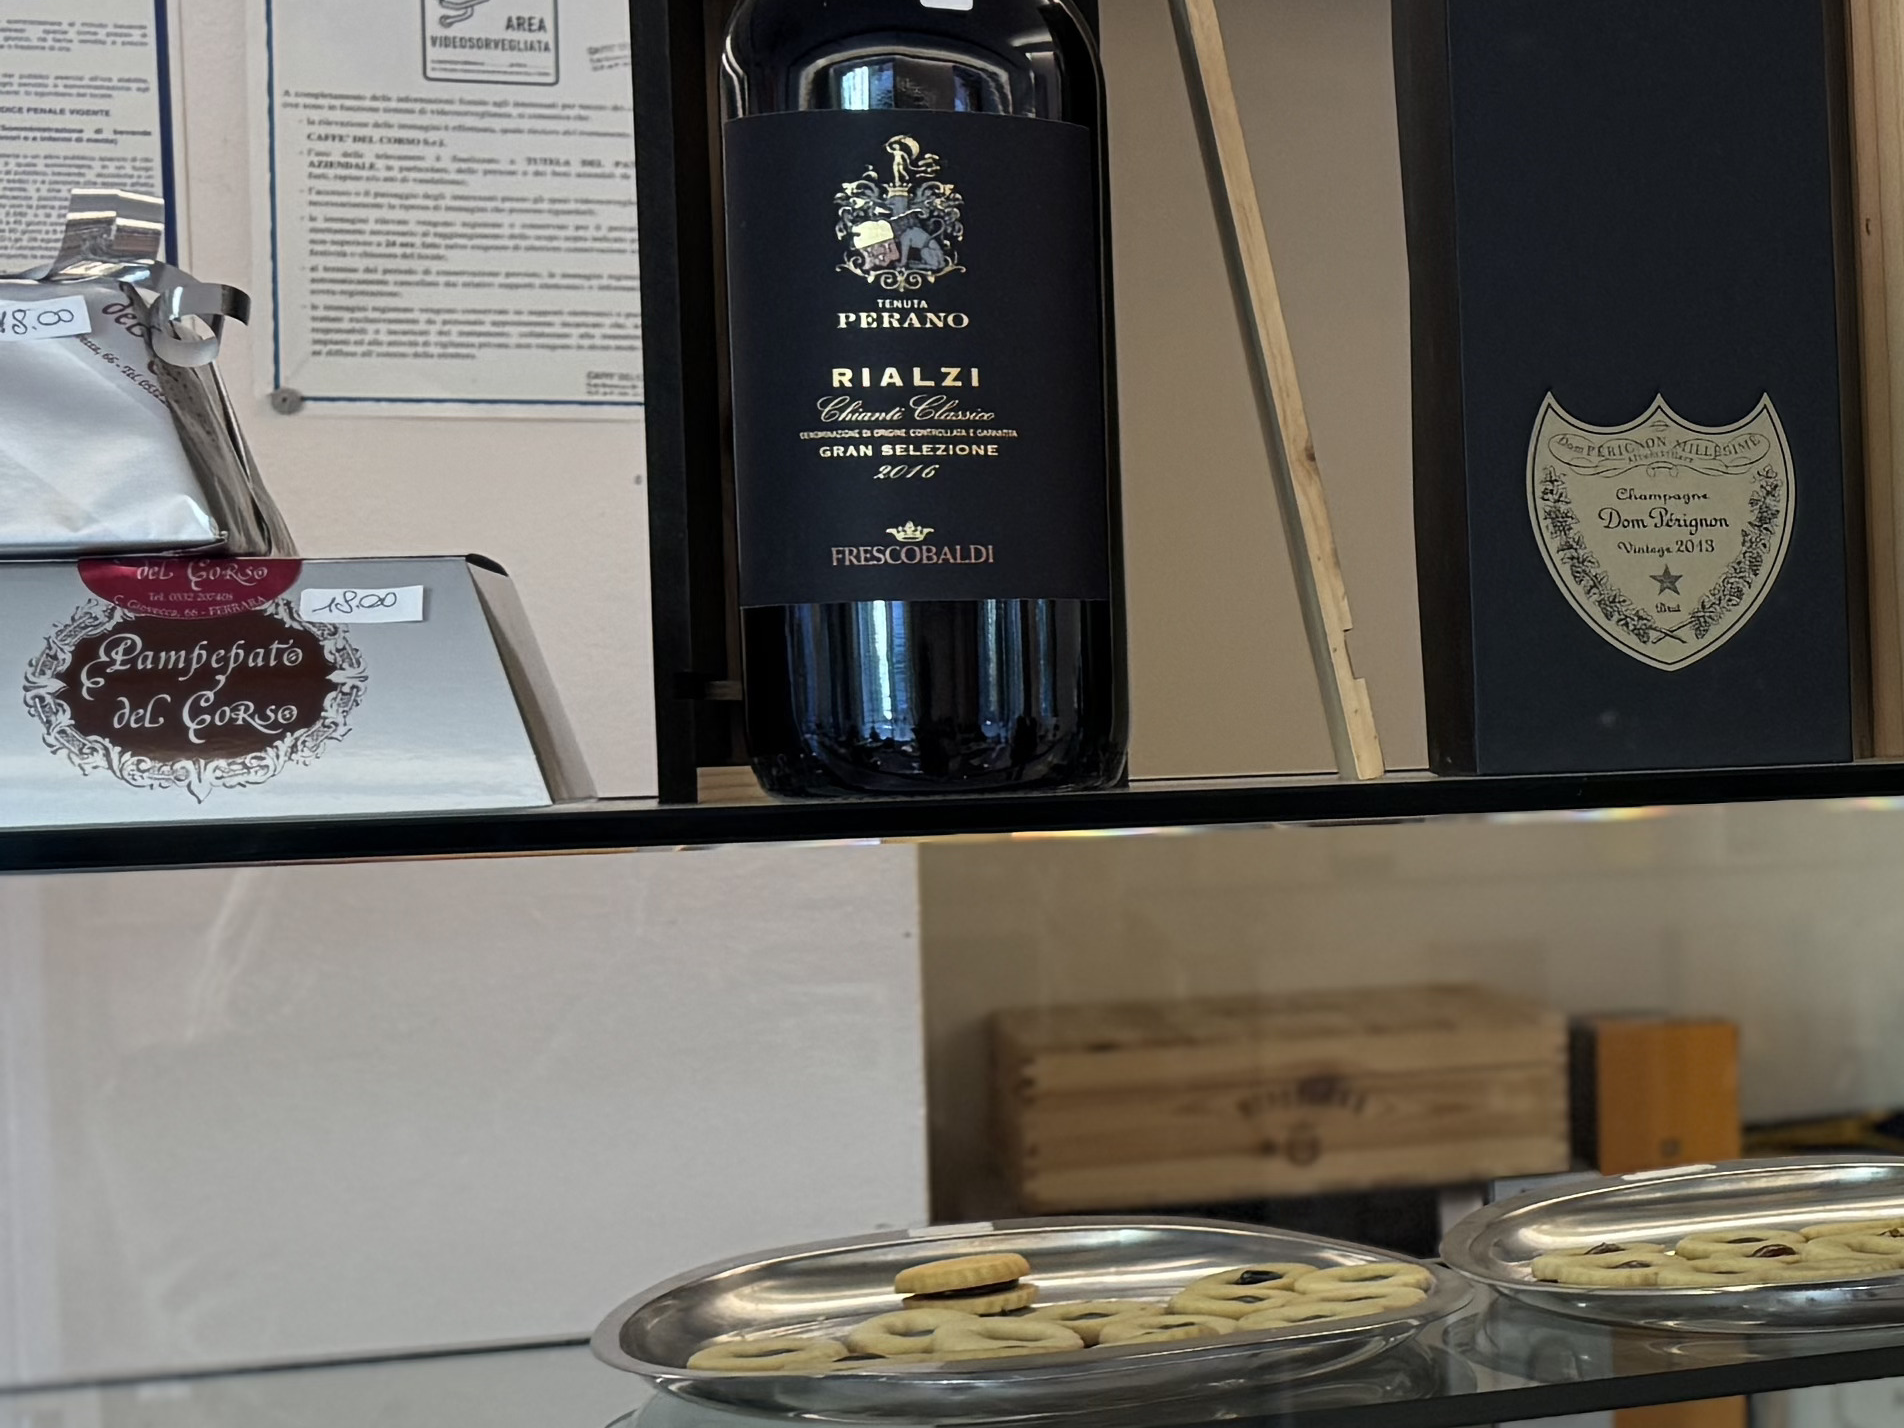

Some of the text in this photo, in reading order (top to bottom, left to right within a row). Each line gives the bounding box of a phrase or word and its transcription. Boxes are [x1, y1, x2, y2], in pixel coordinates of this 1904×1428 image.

[505, 16, 547, 33] AREA
[430, 35, 551, 54] VIDEOSORVEGLIATA
[877, 299, 928, 309] TENUTA
[836, 312, 970, 329] PERANO
[832, 367, 979, 388] RIALZI
[817, 394, 995, 423] Chianti Classico
[819, 444, 999, 458] GRAN SELEZIONE
[873, 464, 940, 480] 2016
[1616, 488, 1710, 505] Champagne
[1598, 507, 1730, 536] Dom Pérignon
[830, 544, 994, 566] FRESCOBALDI
[1617, 541, 1673, 558] Vintage
[81, 633, 303, 700] Pampepato
